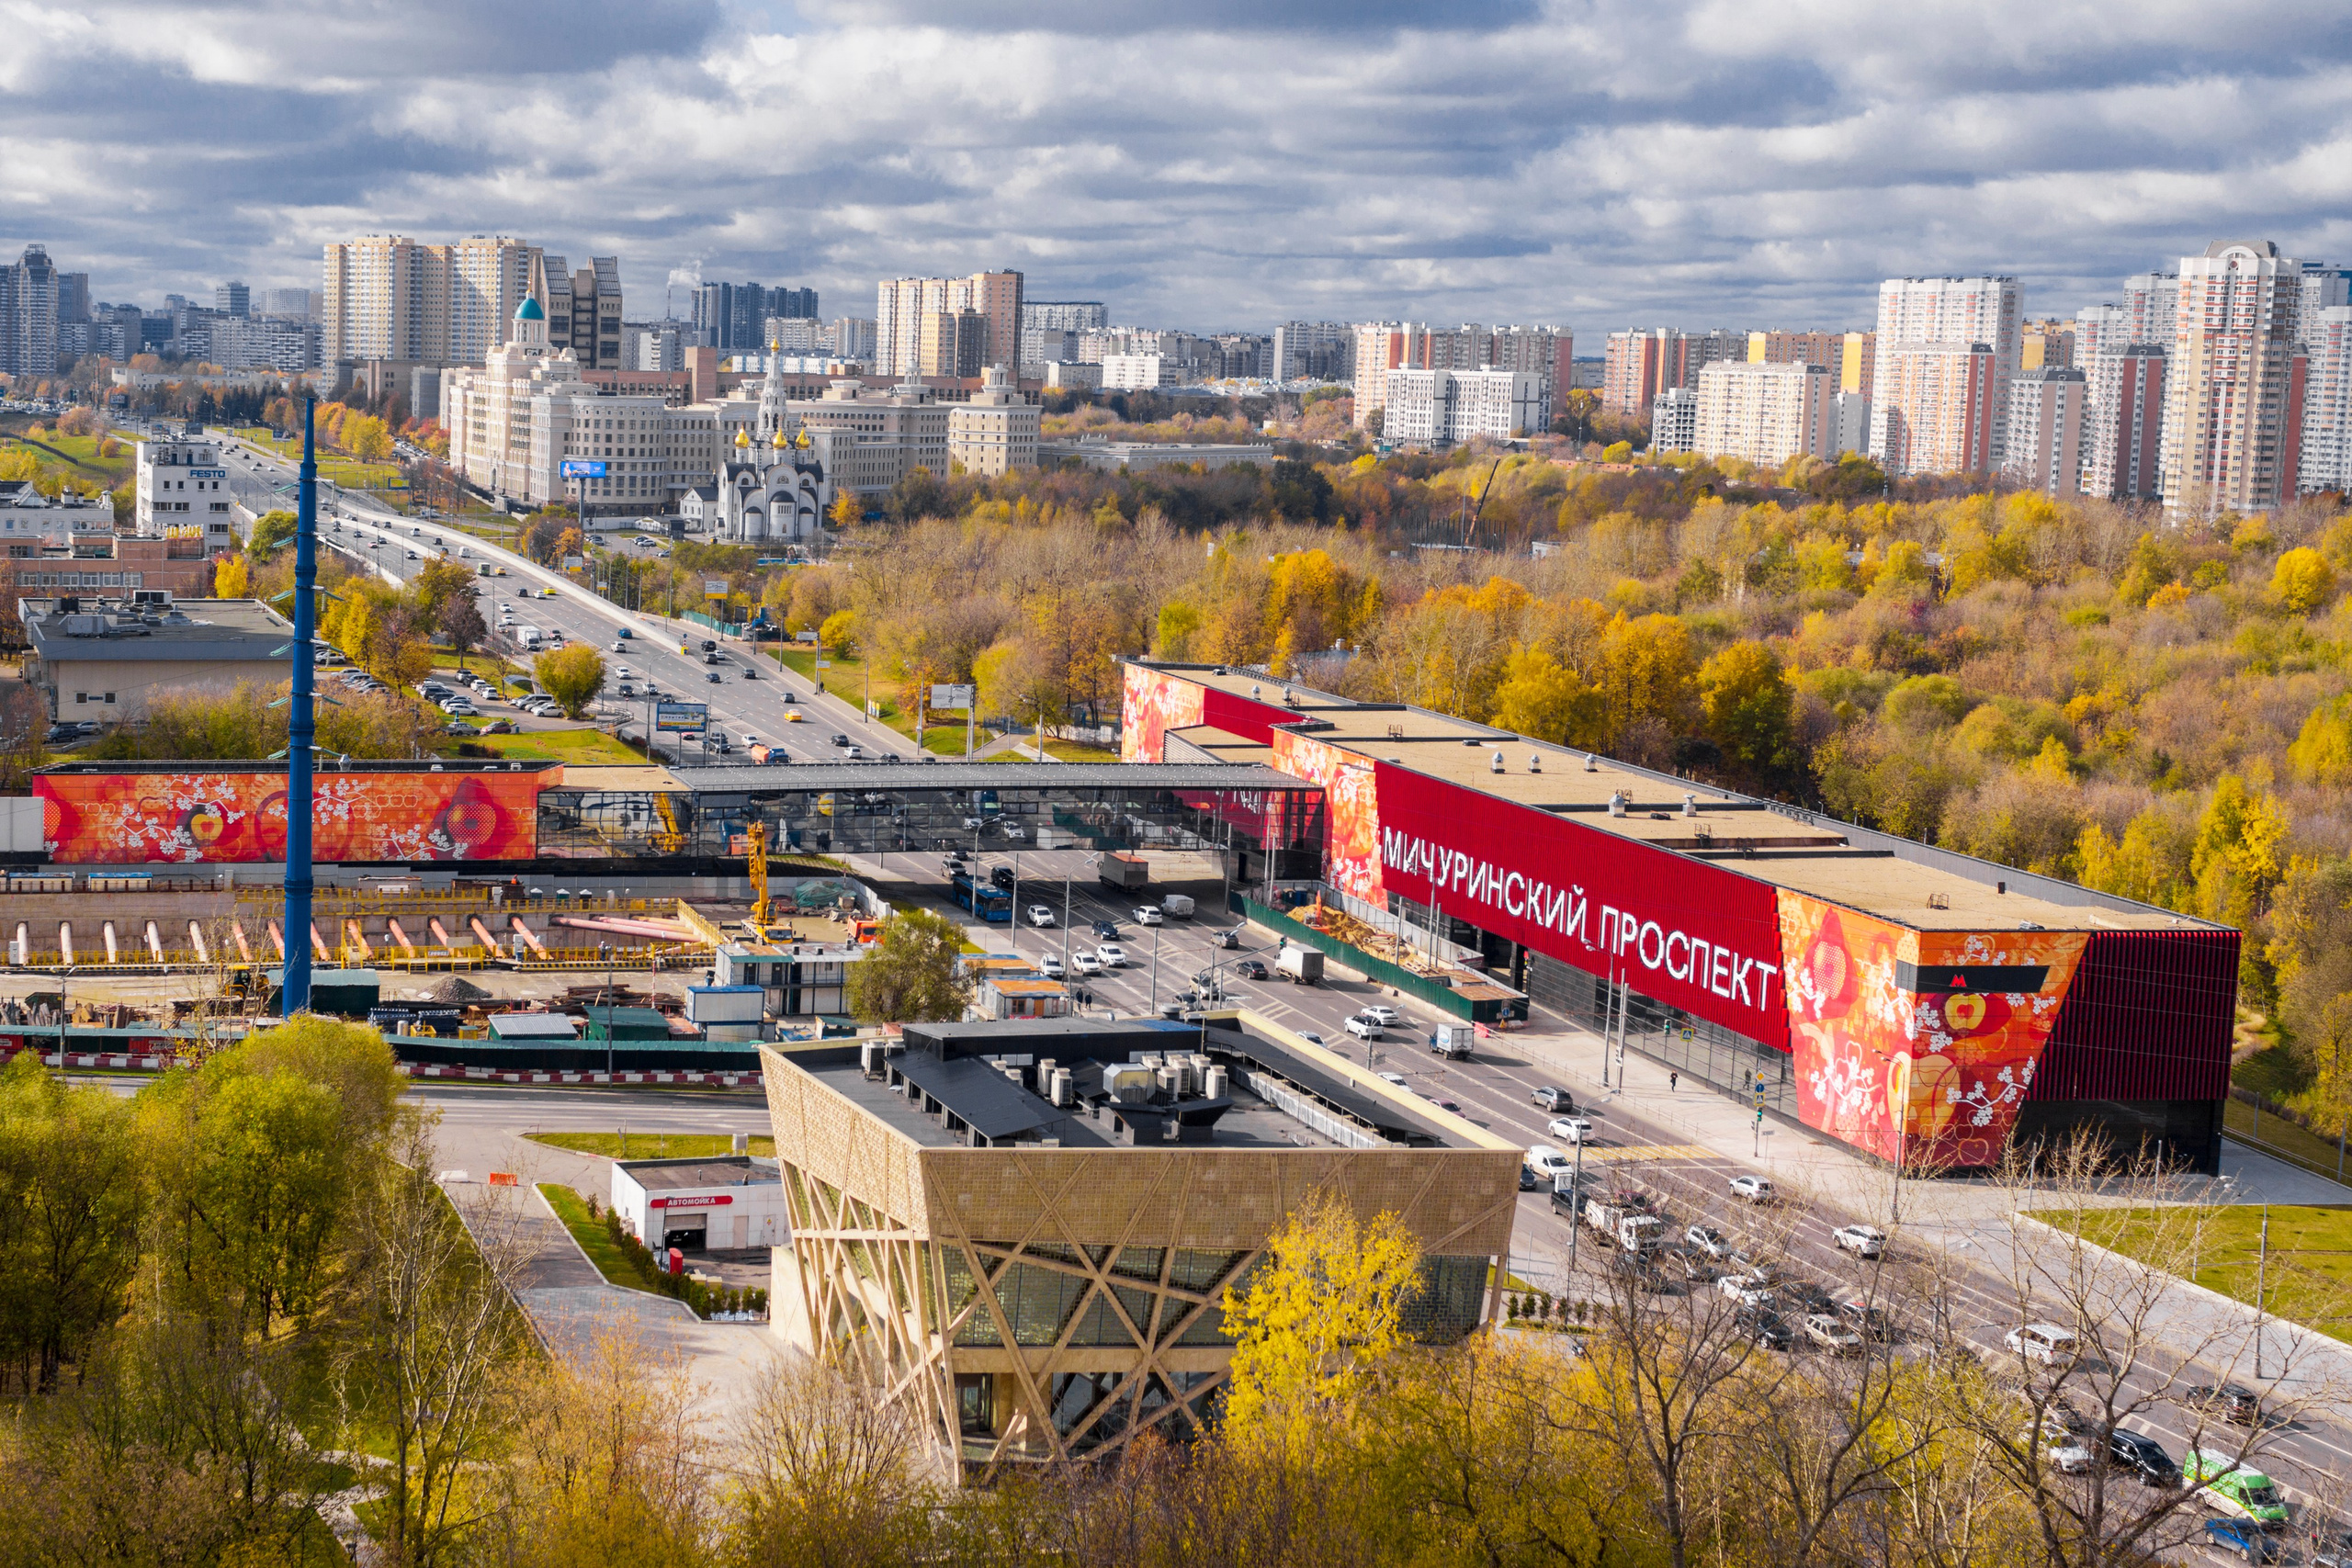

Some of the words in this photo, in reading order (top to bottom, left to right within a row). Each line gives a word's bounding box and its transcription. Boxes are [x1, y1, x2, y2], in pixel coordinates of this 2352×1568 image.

[1383, 826, 1587, 942] МИЧУРИНСКИЙ
[1600, 905, 1778, 1010] ПРОСПЕКТ
[668, 1197, 716, 1206] АВТОМОЙКА
